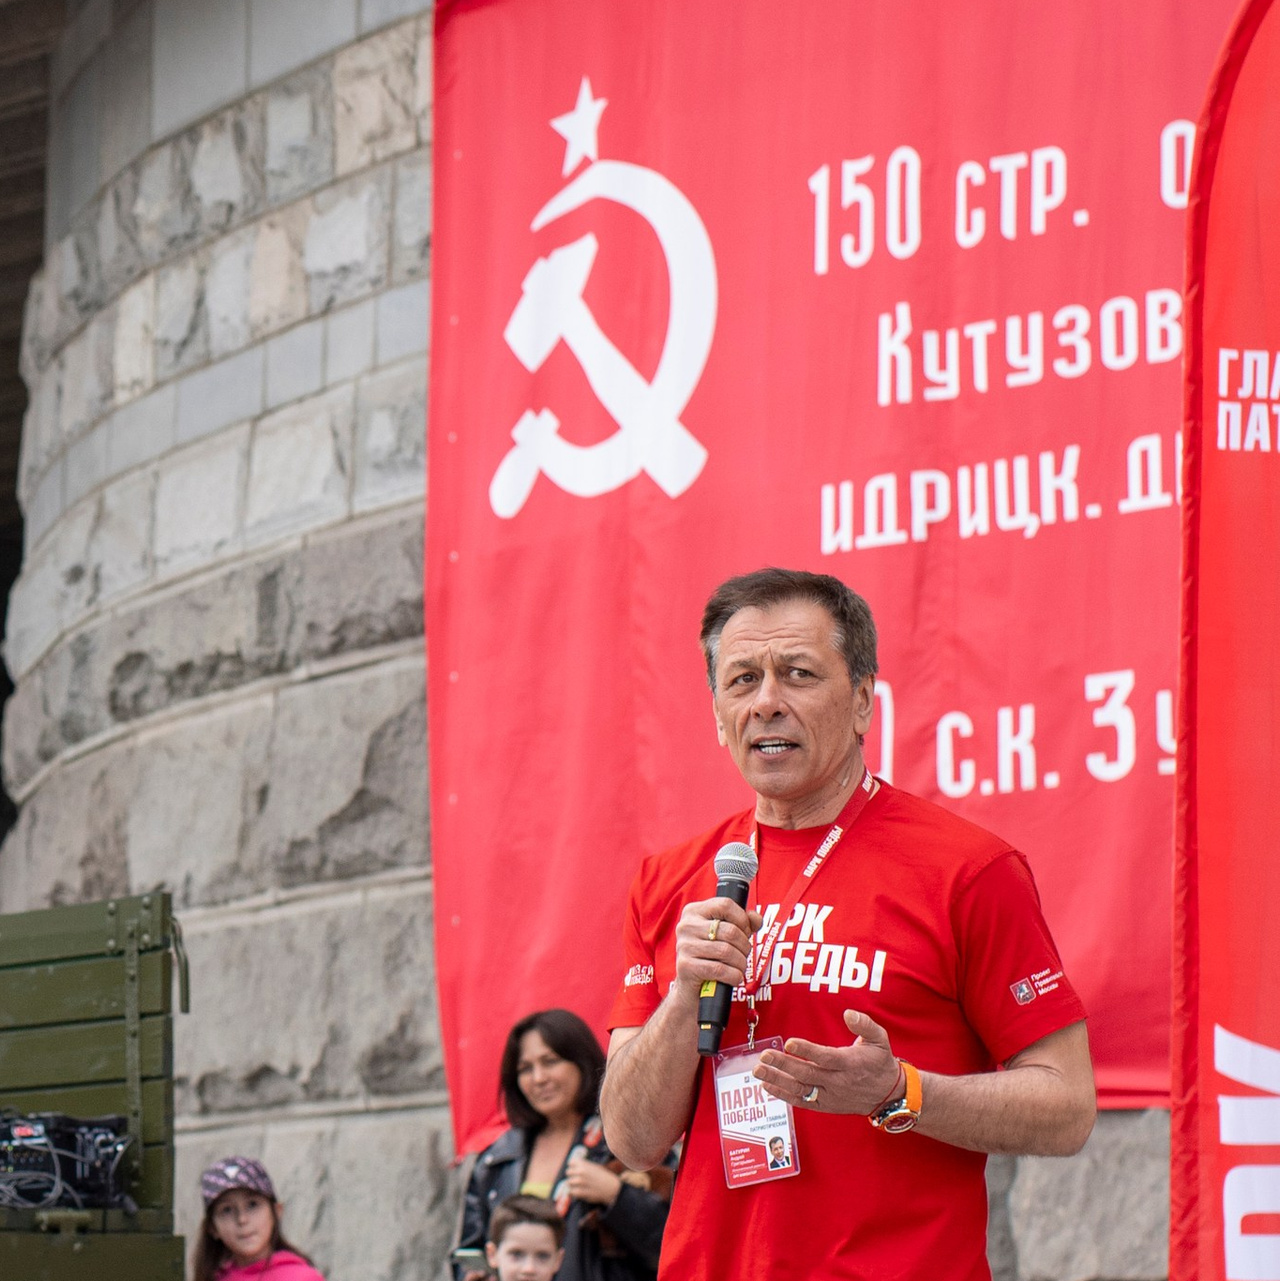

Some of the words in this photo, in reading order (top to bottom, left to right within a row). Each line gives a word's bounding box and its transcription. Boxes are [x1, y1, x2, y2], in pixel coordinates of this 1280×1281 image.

[807, 145, 922, 276] 150
[802, 855, 823, 878] ПАРК
[816, 825, 843, 858] ПОБЕДЫ
[756, 903, 834, 943] АРК
[756, 941, 887, 994] БЕДЫ
[721, 1084, 765, 1111] ПАРК
[723, 1105, 767, 1126] ПОБЕДЫ
